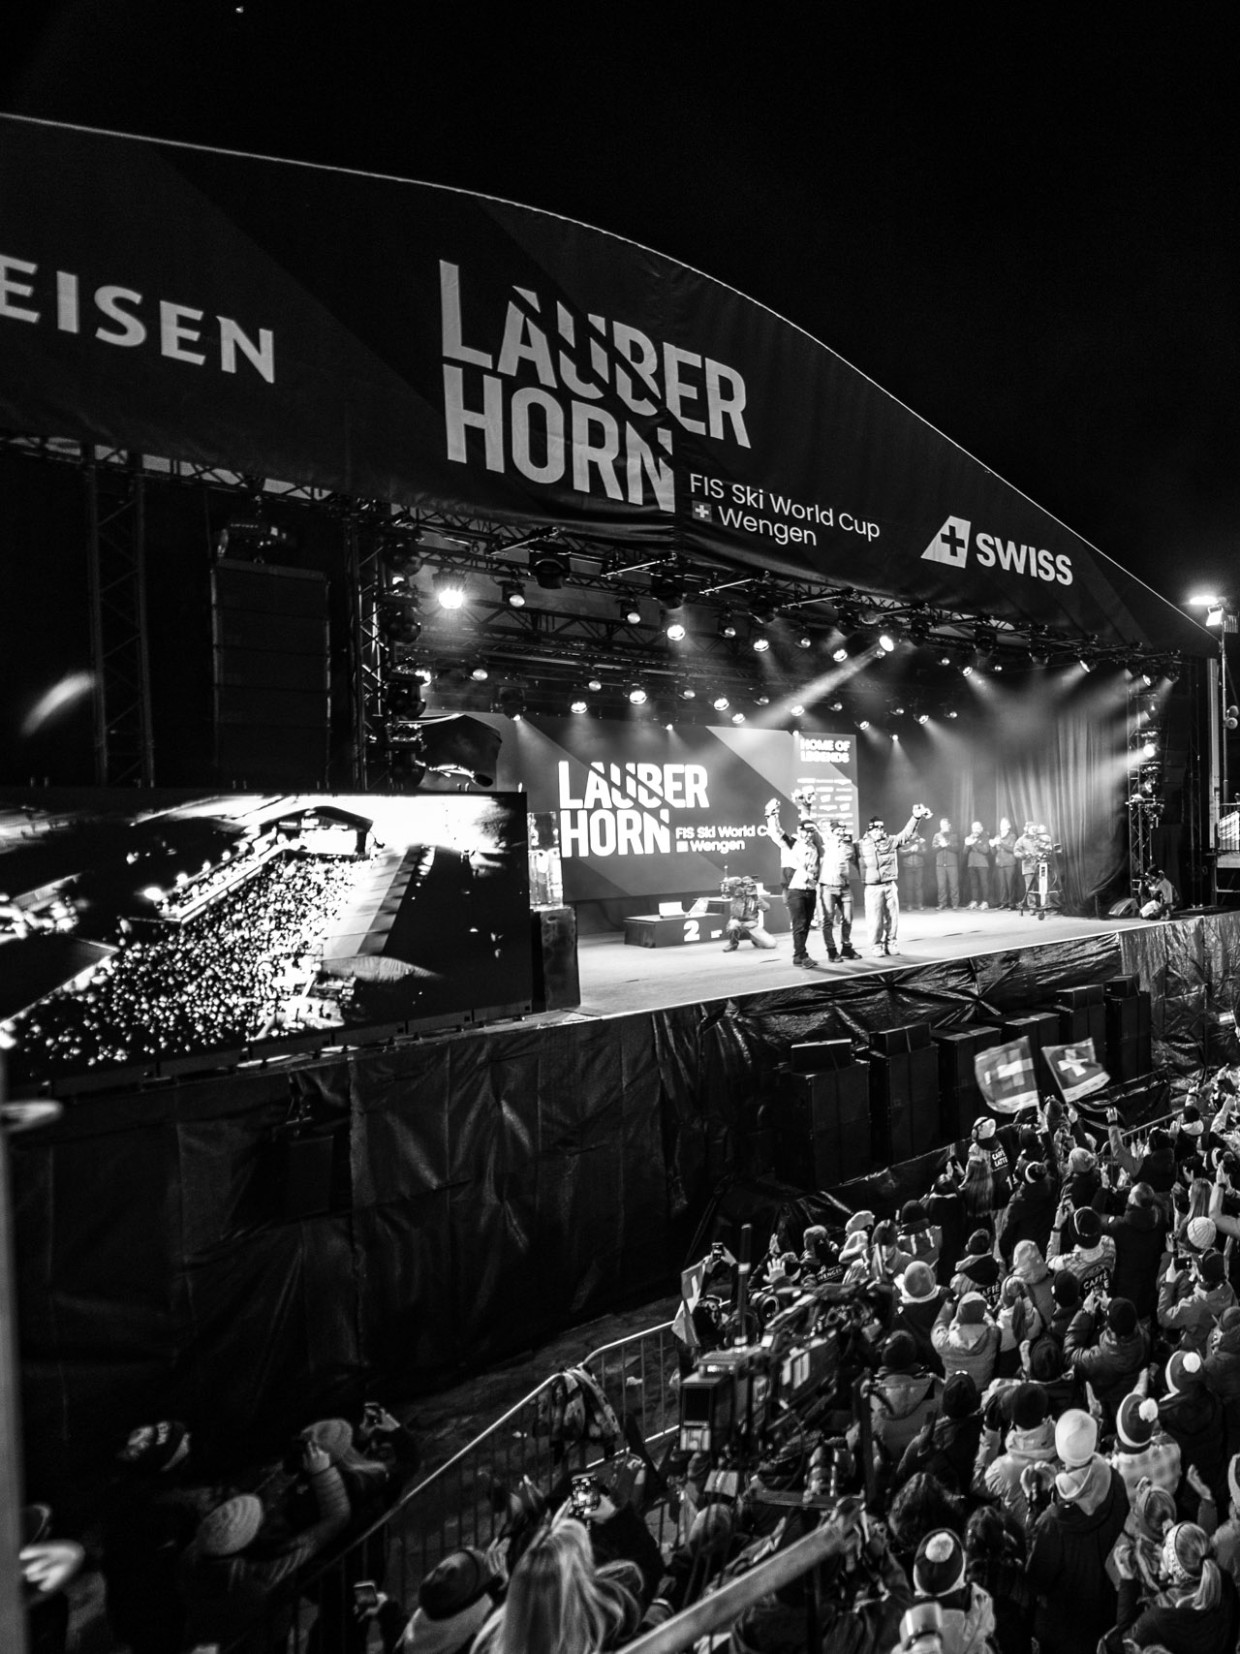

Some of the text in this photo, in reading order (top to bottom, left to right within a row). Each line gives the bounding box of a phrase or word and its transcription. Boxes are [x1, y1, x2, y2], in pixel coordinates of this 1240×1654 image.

[439, 259, 751, 449] LAUBER
[442, 363, 676, 514] HORN
[690, 473, 880, 542] FIS Ski World Cup
[718, 505, 817, 546] Wengen
[975, 532, 1074, 586] SWISS
[835, 740, 851, 752] OF
[558, 760, 710, 810] LAUBER
[560, 808, 671, 858] HORN
[675, 826, 695, 839] FIS
[718, 824, 756, 838] World
[690, 840, 746, 854] Wengen
[683, 920, 701, 942] 2
